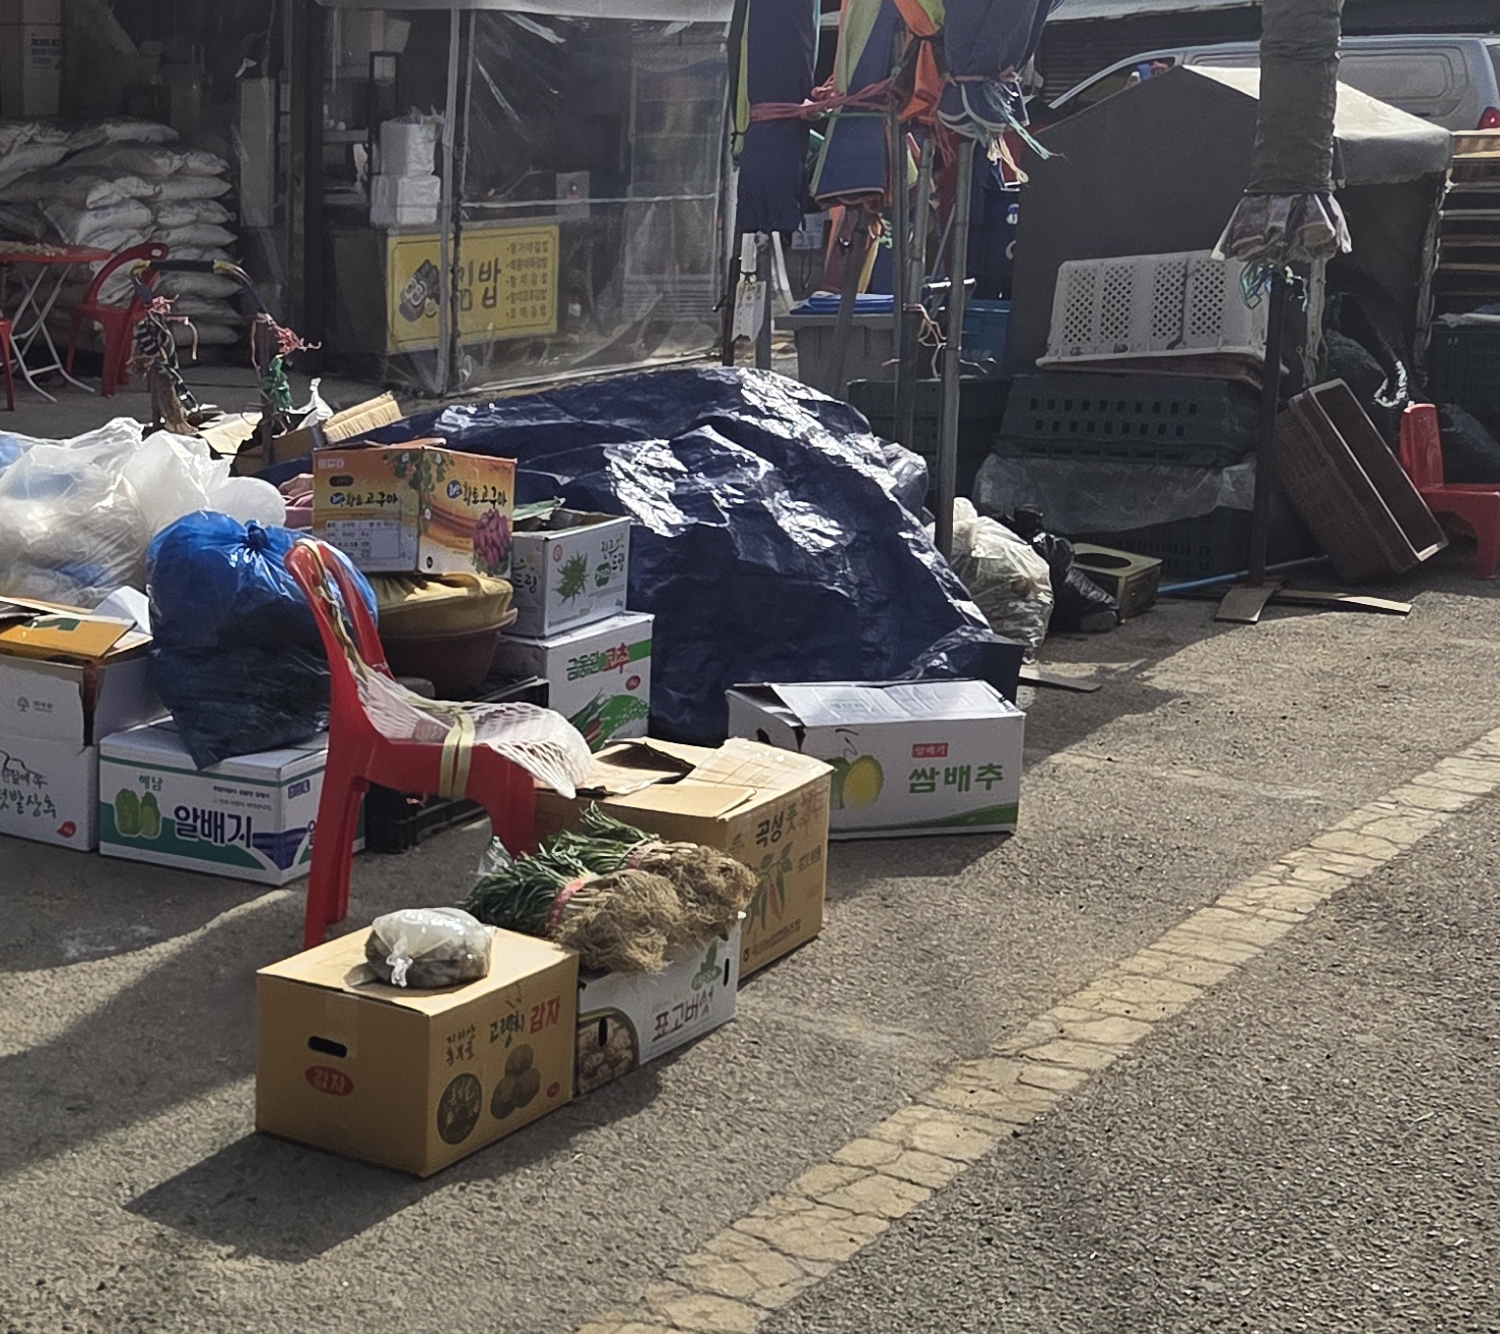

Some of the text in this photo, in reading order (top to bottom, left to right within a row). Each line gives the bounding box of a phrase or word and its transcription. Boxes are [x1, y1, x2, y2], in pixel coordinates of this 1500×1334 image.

[908, 762, 1004, 794] 쌈배추
[173, 805, 253, 849] 알배기
[530, 995, 561, 1034] 감자
[651, 985, 714, 1043] 표고버섯
